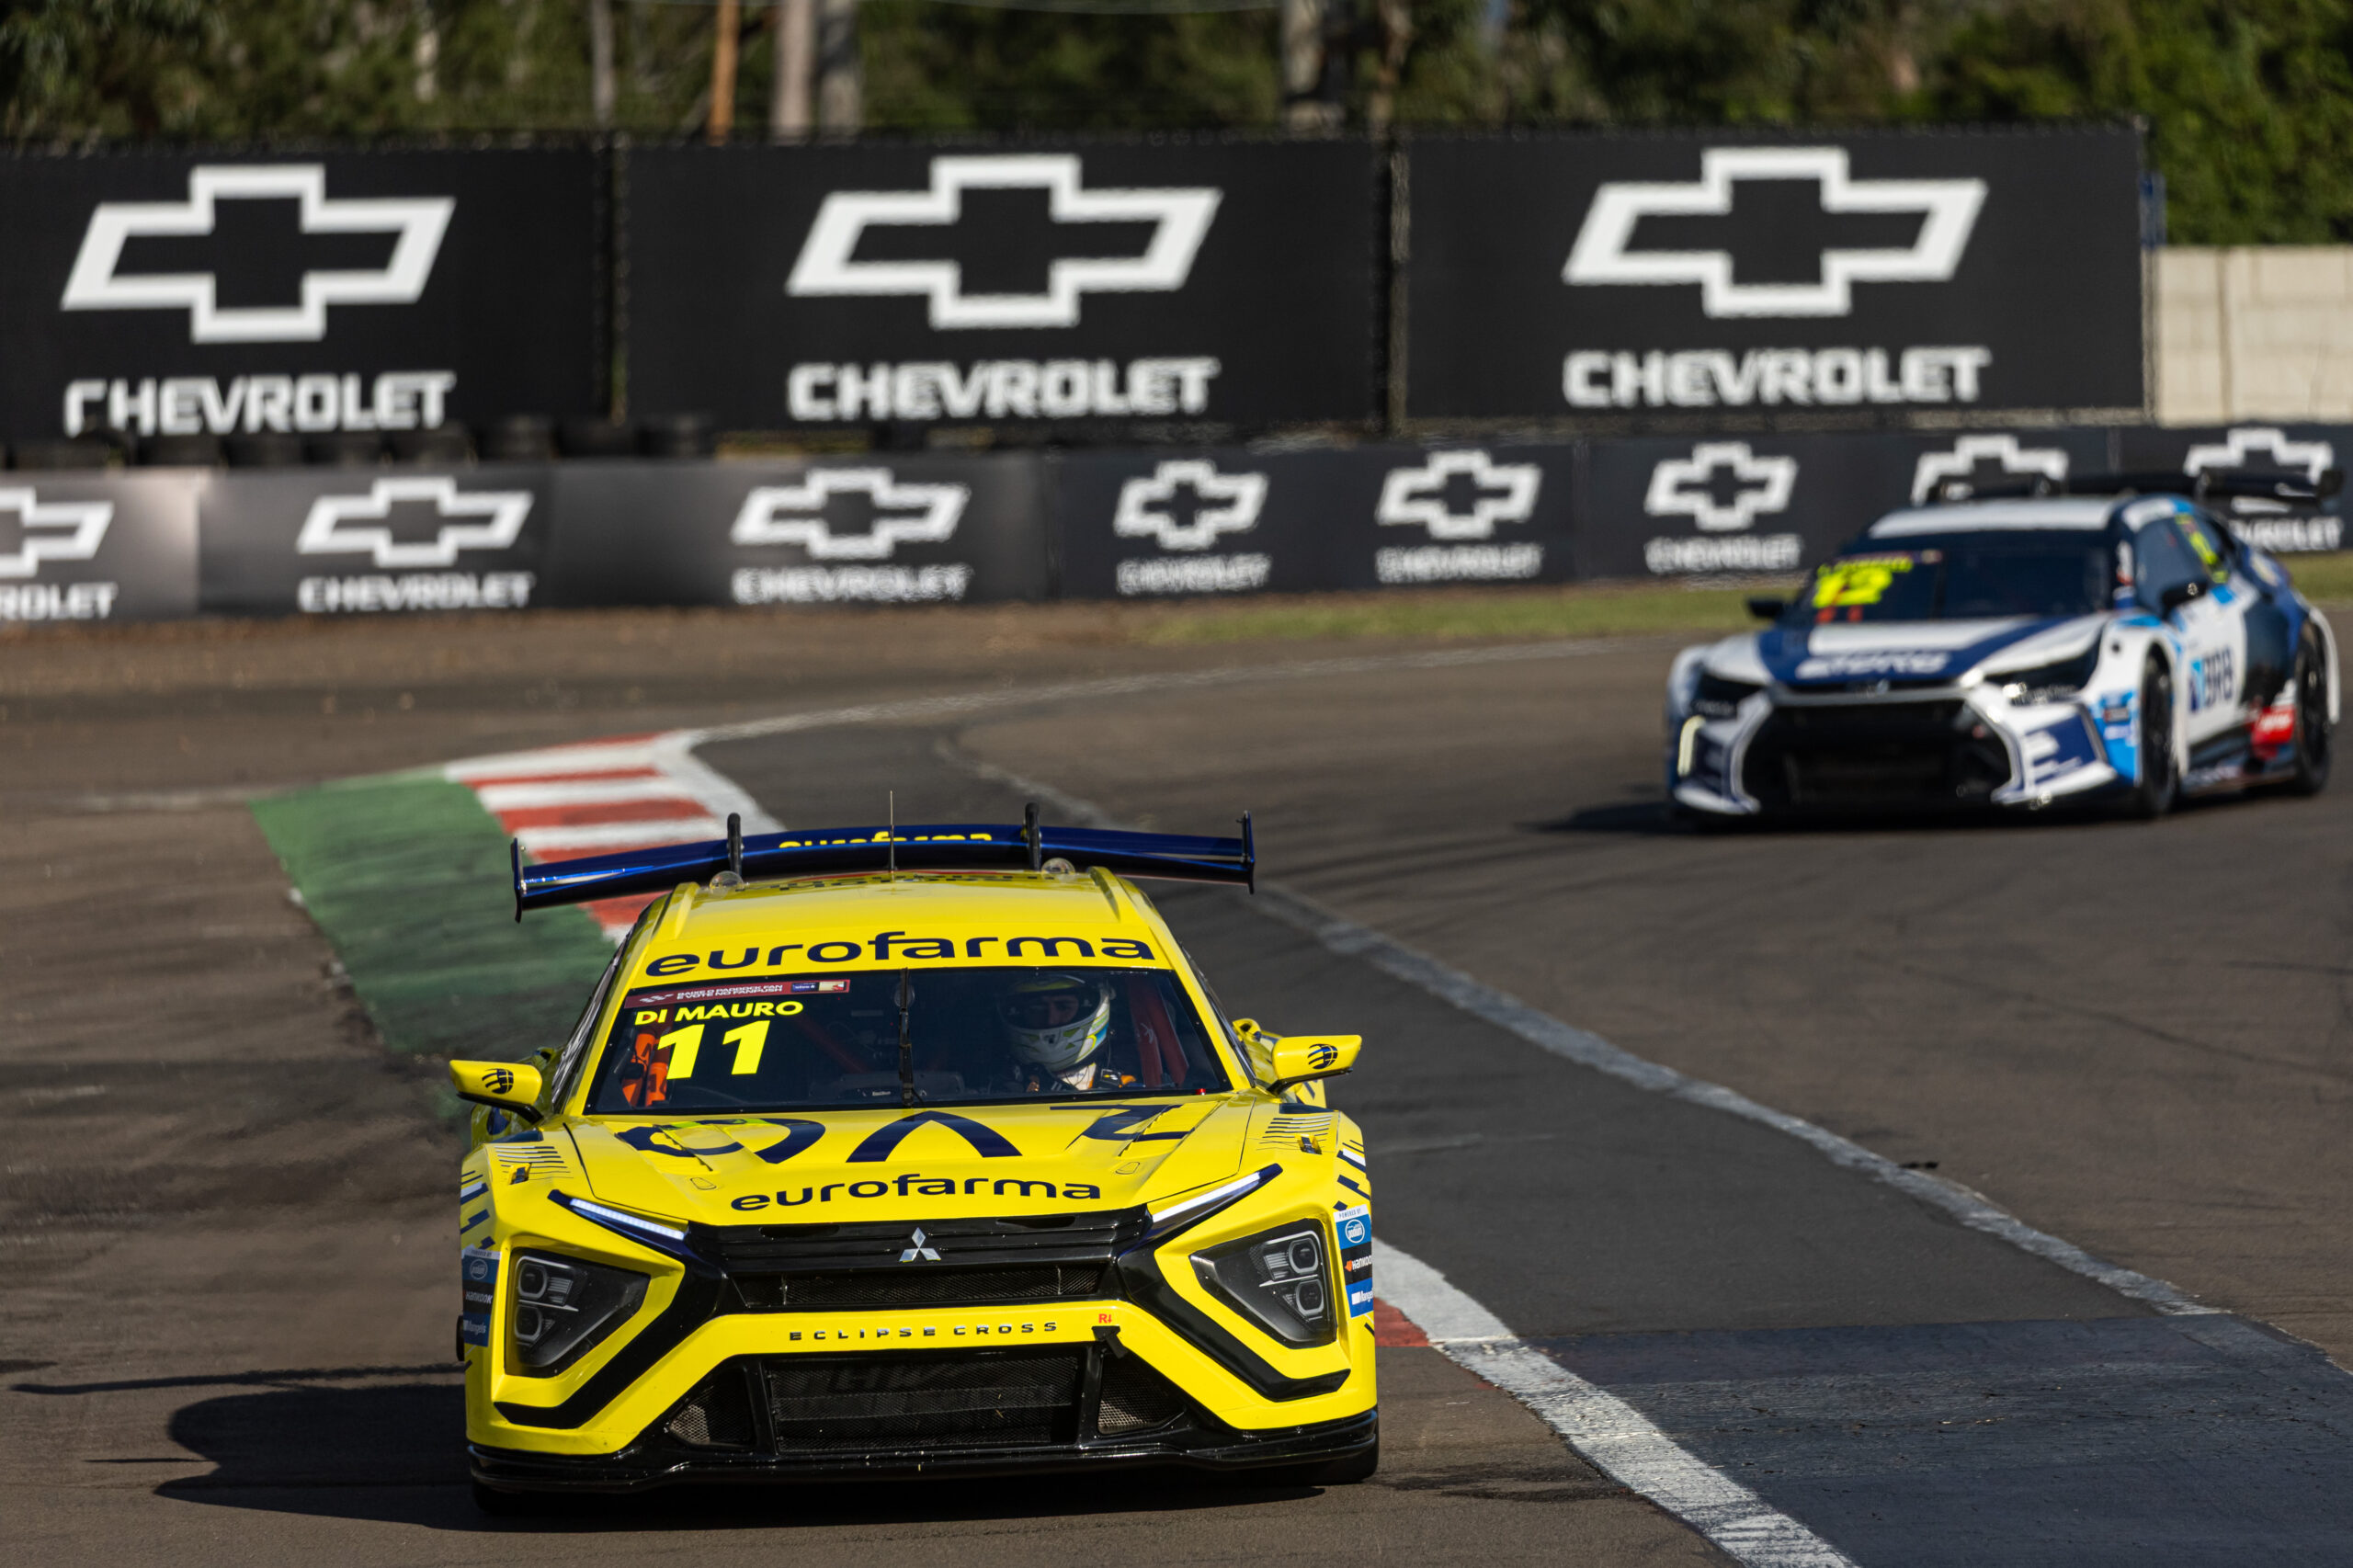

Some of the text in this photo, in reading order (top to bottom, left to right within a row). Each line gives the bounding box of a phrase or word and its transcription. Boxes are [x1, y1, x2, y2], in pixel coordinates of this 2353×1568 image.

[788, 357, 1220, 420] CHEVROLET
[1562, 346, 1991, 407] CHEVROLET
[64, 371, 456, 436] CHEVROLET
[298, 572, 535, 613] CHEVROLET
[732, 563, 972, 605] CHEVROLET
[644, 930, 1155, 978] eurofarma
[634, 1001, 804, 1026] DI MAURO
[657, 1020, 770, 1080] 11
[730, 1173, 1101, 1211] eurofarma
[789, 1321, 1058, 1342] ECLIPSE CROSS
